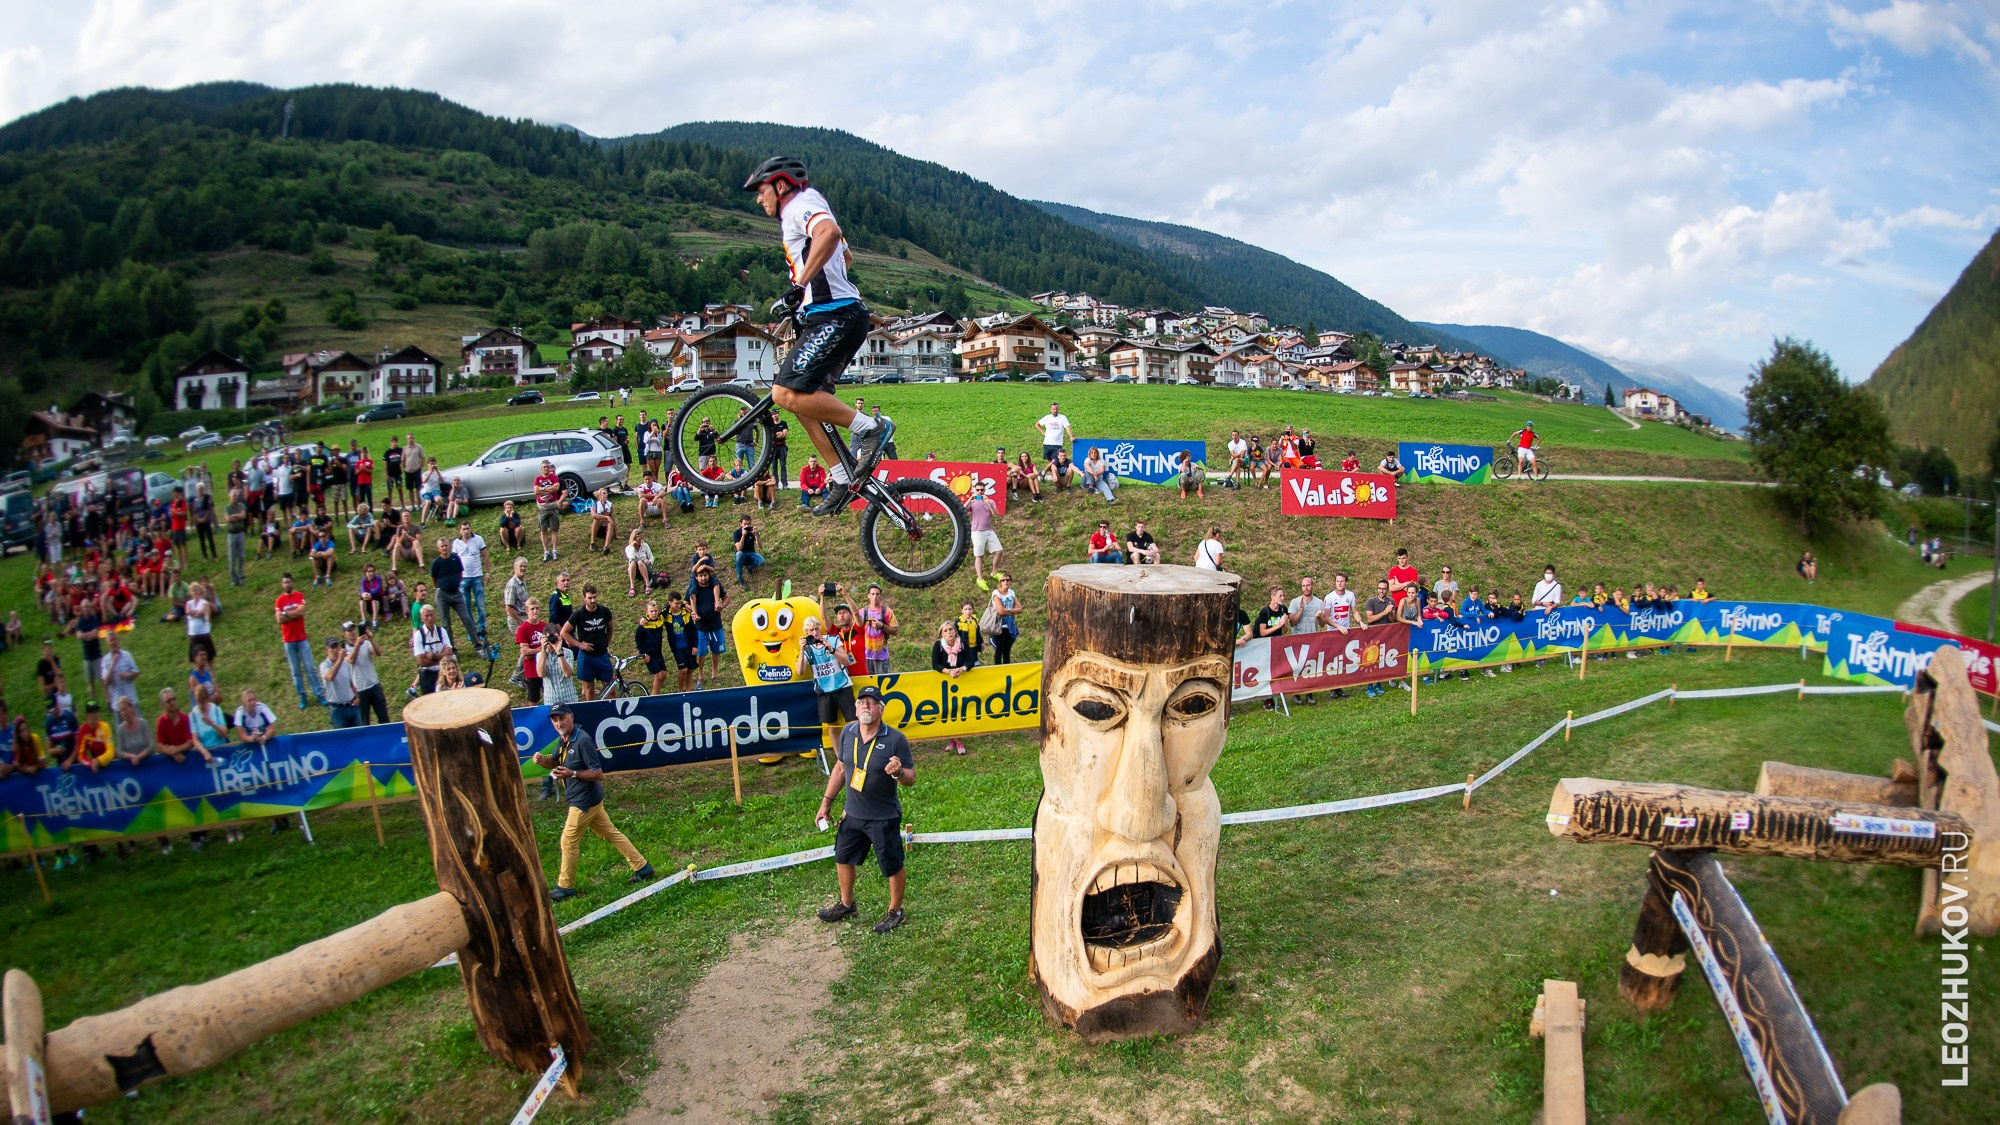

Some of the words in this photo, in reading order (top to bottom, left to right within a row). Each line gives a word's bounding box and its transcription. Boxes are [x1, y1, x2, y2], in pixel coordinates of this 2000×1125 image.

[1098, 446, 1182, 477] TRENTINO
[1414, 450, 1480, 475] TRENTINO
[1289, 478, 1326, 508] Val
[1327, 489, 1341, 505] di
[1342, 478, 1388, 506] Sole
[1535, 615, 1595, 641] TRENTINO
[1630, 610, 1683, 632] TRENTINO
[1720, 608, 1782, 631] TRENTINO
[1431, 625, 1500, 654] TRENTINO
[758, 667, 792, 677] Melinda
[815, 662, 834, 671] VIDEO
[1284, 644, 1325, 682] Val
[1326, 652, 1343, 677] di
[1344, 639, 1399, 675] Sole
[595, 696, 790, 760] Melinda
[206, 750, 330, 797] TRENTINO
[36, 777, 142, 820] TRENTINO
